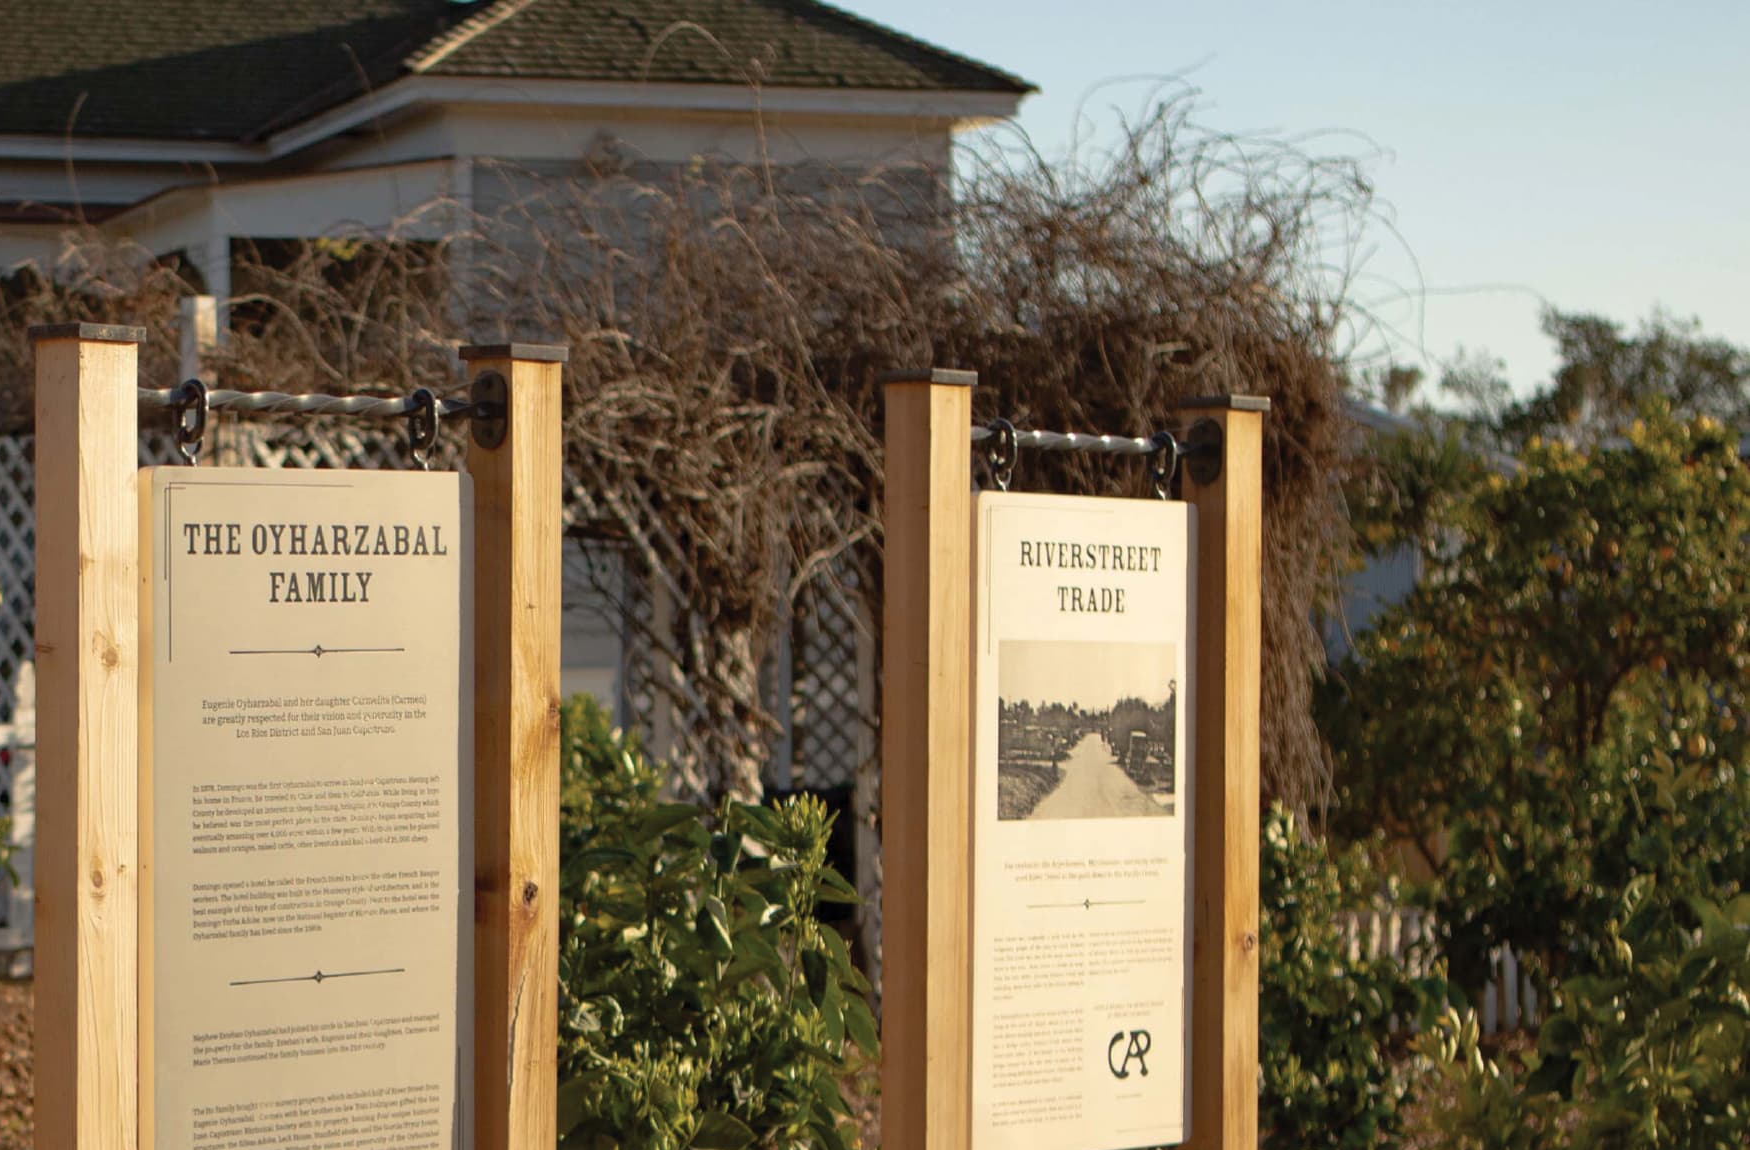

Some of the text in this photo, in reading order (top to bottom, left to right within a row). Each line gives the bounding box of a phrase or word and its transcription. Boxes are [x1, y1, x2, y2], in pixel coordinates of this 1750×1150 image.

[183, 523, 447, 556] THE OYHARZABAL
[1020, 540, 1161, 572] RIVERSTREET
[269, 572, 373, 603] FAMILY
[1057, 586, 1125, 613] TRADE
[283, 699, 297, 707] and
[217, 715, 244, 726] greatly
[247, 714, 285, 725] respected
[301, 713, 319, 721] their
